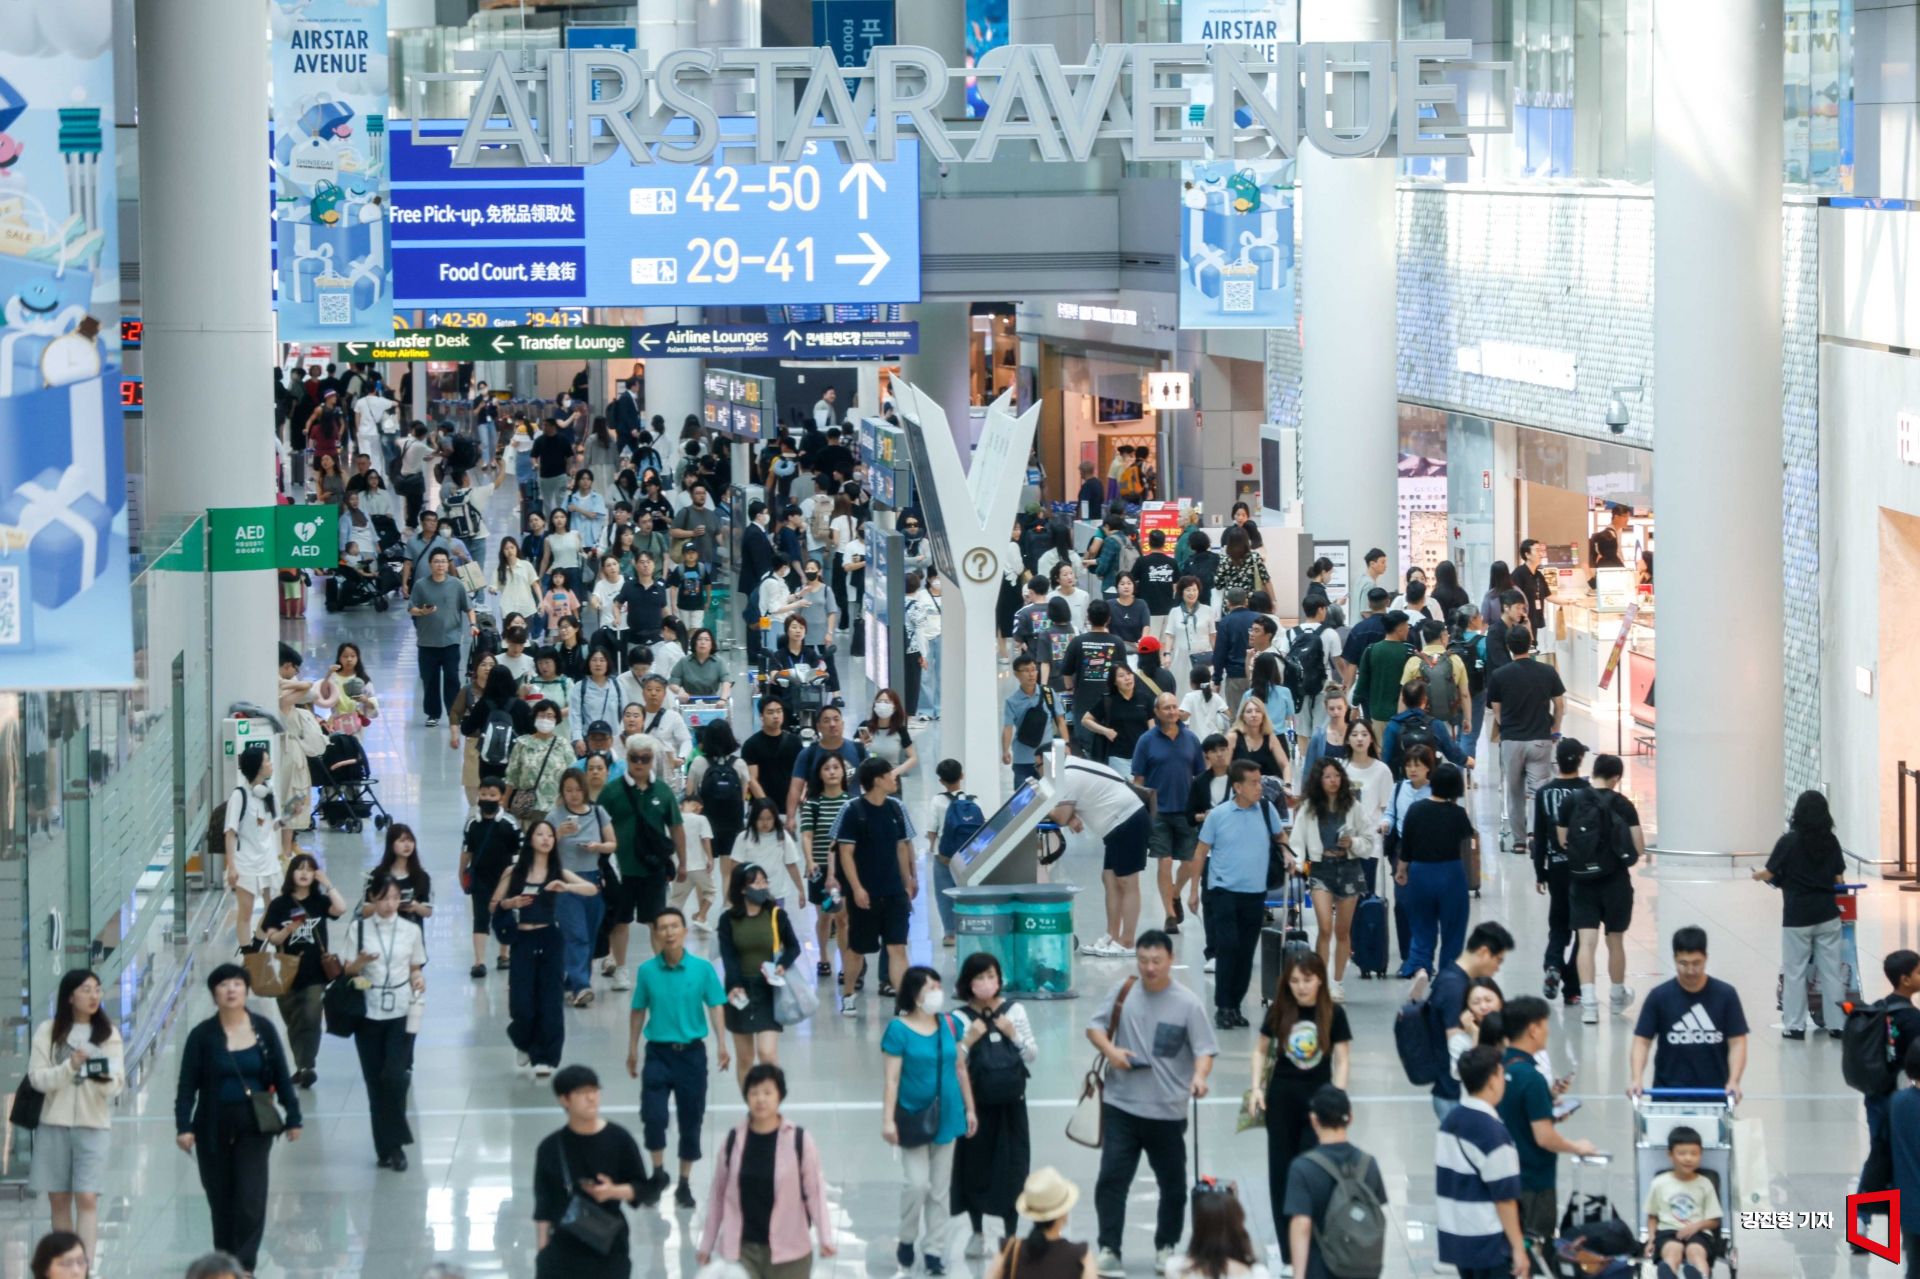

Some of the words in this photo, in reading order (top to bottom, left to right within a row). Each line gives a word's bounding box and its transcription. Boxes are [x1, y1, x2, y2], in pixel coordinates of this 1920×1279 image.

[291, 30, 368, 49] AIRSTAR
[843, 19, 854, 52] FOOD
[1202, 20, 1277, 40] AIRSTAR
[293, 54, 367, 73] AVENUE
[450, 45, 963, 168] AIRSTAR
[966, 40, 1472, 162] AVENUE
[686, 165, 820, 213] 42-50
[389, 205, 422, 223] Free
[424, 204, 484, 227] Pick-up,
[486, 204, 576, 224] 免税品领取处
[686, 236, 815, 283] 29-41
[439, 262, 479, 282] Food
[481, 263, 529, 282] Court,
[530, 261, 577, 282] 美食街
[442, 312, 488, 328] 42-50
[434, 332, 470, 347] Desk
[518, 334, 573, 350] Transfer
[574, 334, 625, 352] Lounge
[665, 329, 711, 344] Airline
[712, 329, 769, 346] Lounges
[372, 349, 397, 358] Other
[398, 349, 430, 358] Airlines
[688, 345, 713, 353] Airlines,
[713, 345, 744, 354] Singapore
[235, 525, 265, 540] AED
[291, 545, 320, 557] AED
[1667, 1029, 1723, 1045] adidas
